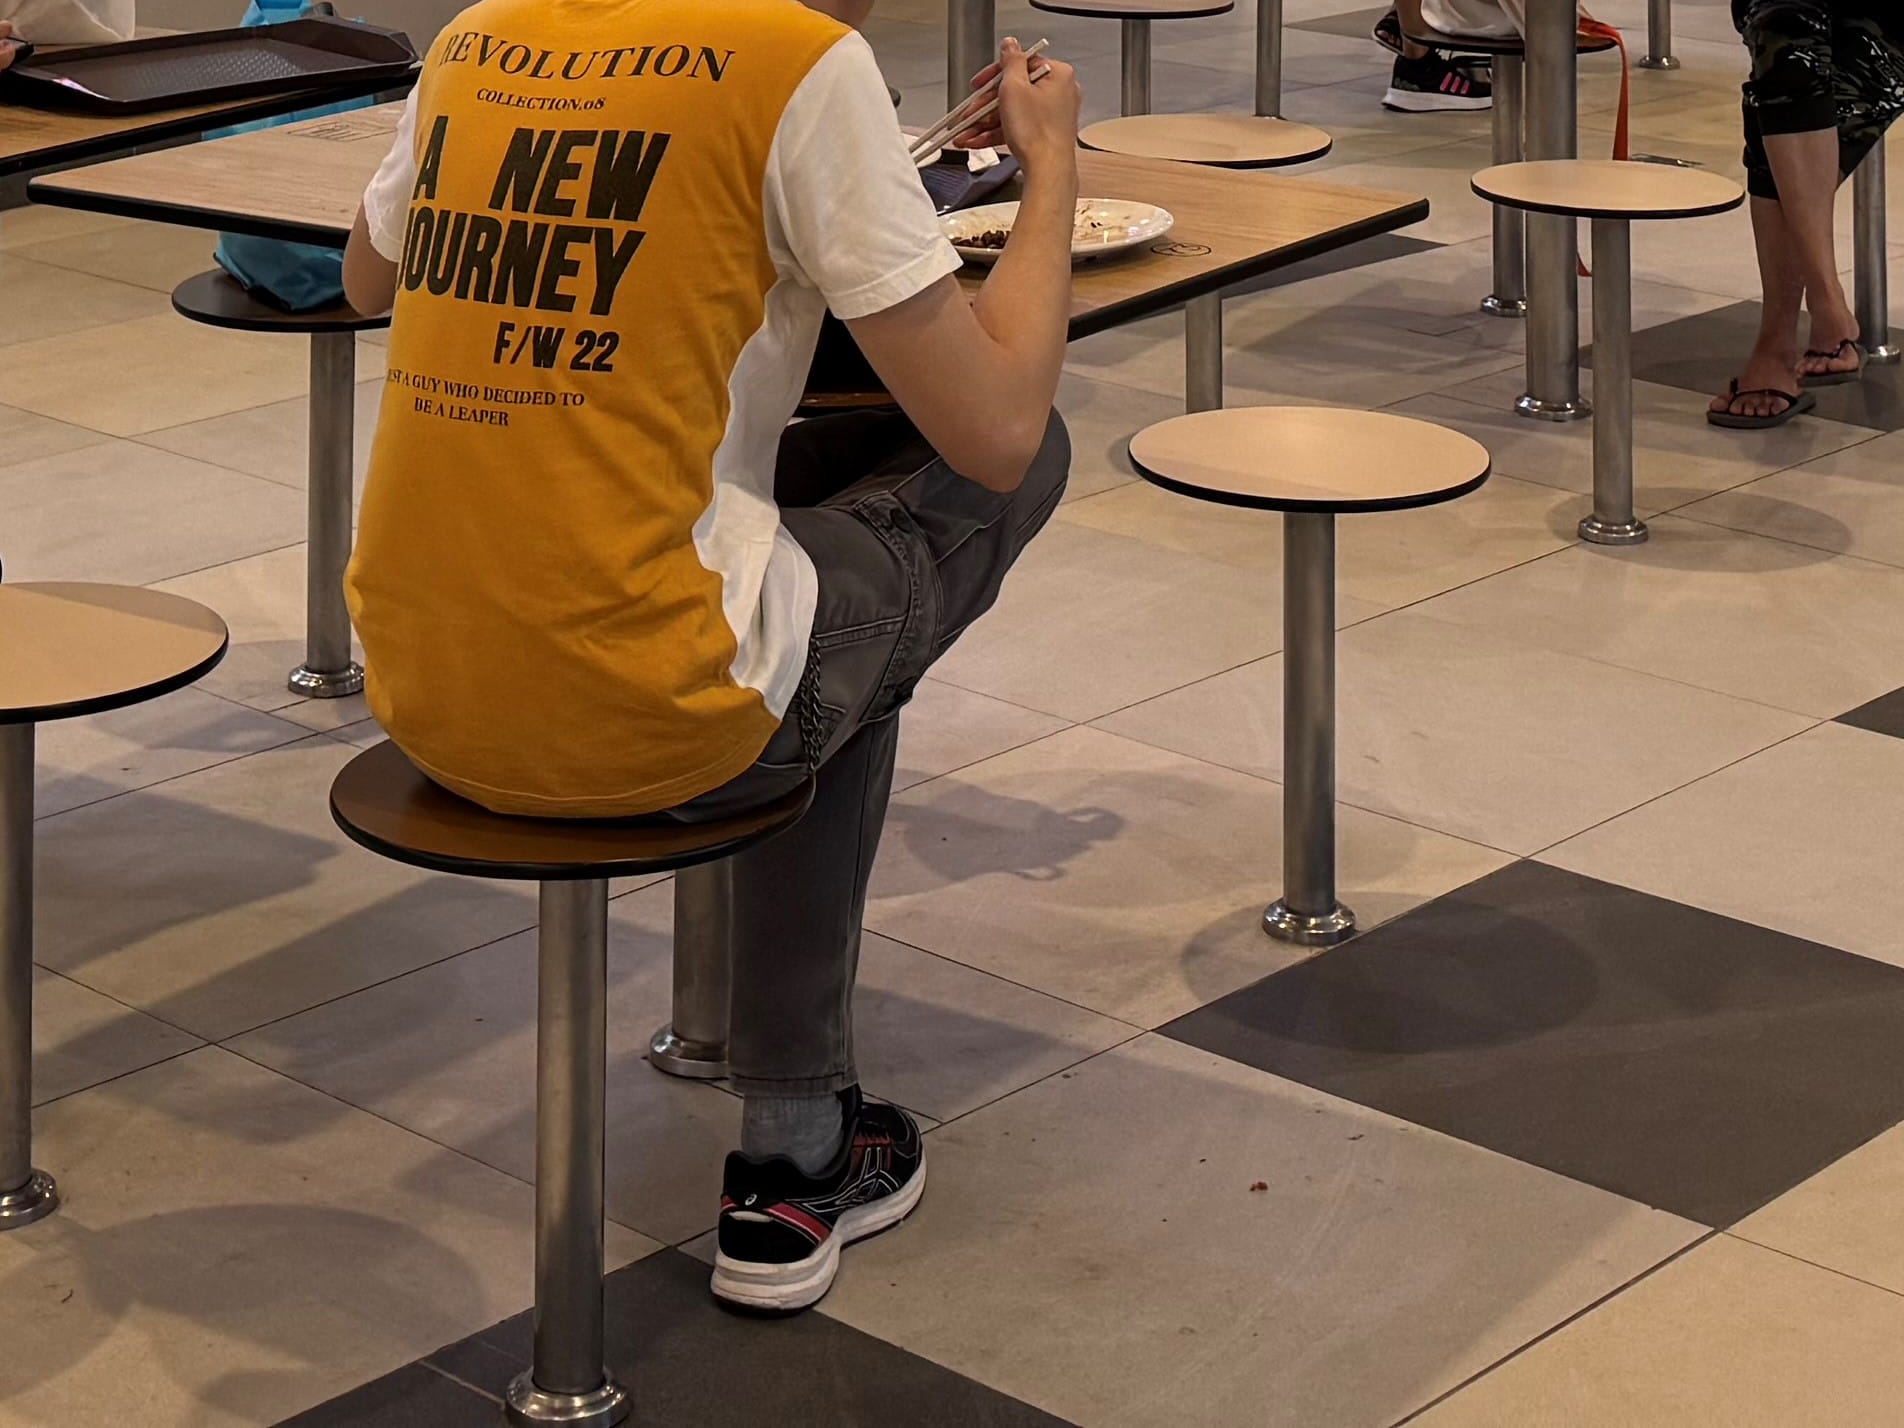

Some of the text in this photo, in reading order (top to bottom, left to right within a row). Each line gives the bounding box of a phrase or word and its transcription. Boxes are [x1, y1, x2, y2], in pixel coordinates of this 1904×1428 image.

[439, 31, 736, 83] REVOLUTION
[412, 115, 672, 222] A NEW
[492, 321, 620, 373] F/W 22
[412, 374, 441, 393] GUY
[444, 380, 479, 400] WHO
[483, 386, 557, 407] DECIDED
[561, 391, 586, 407] TO
[434, 402, 445, 417] A
